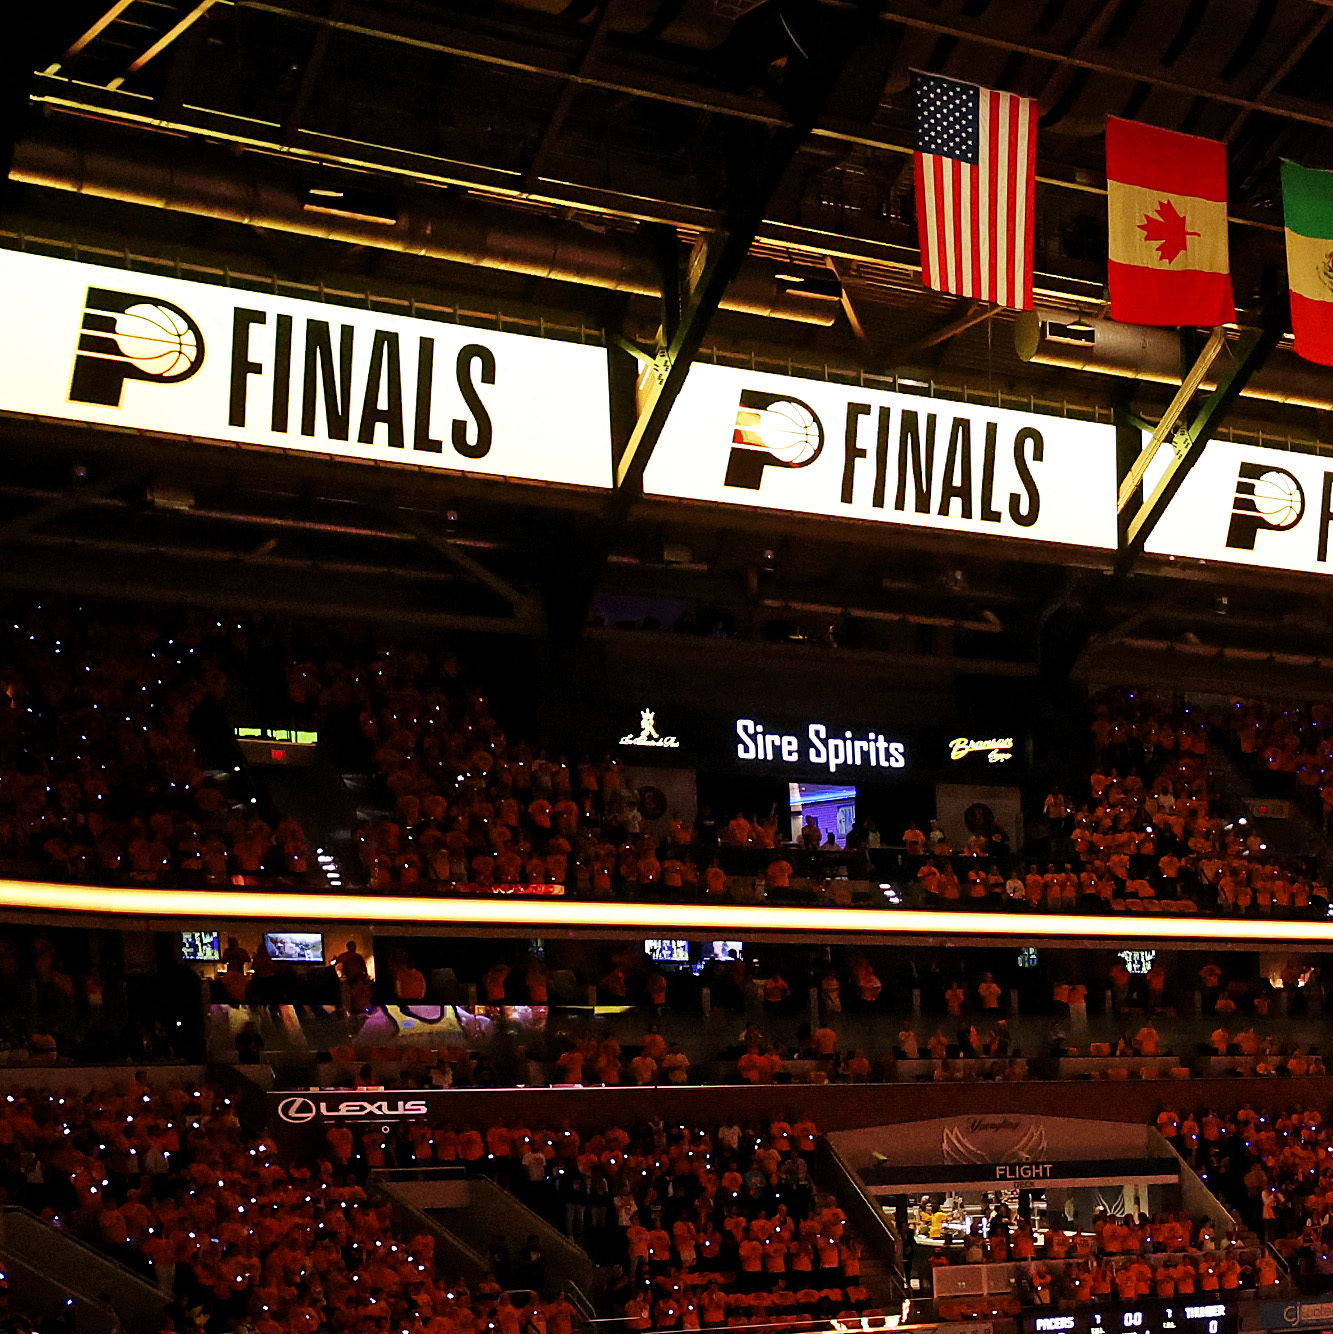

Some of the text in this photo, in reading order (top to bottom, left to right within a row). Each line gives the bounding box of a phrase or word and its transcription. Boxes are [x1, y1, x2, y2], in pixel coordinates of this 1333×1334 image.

[228, 305, 498, 460] FINALS
[840, 401, 1045, 528] FINALS
[736, 718, 906, 773] Sire Spirits
[319, 1099, 428, 1117] LEXUS
[995, 1163, 1054, 1180] FLIGHT
[1035, 1316, 1075, 1331] PACERS
